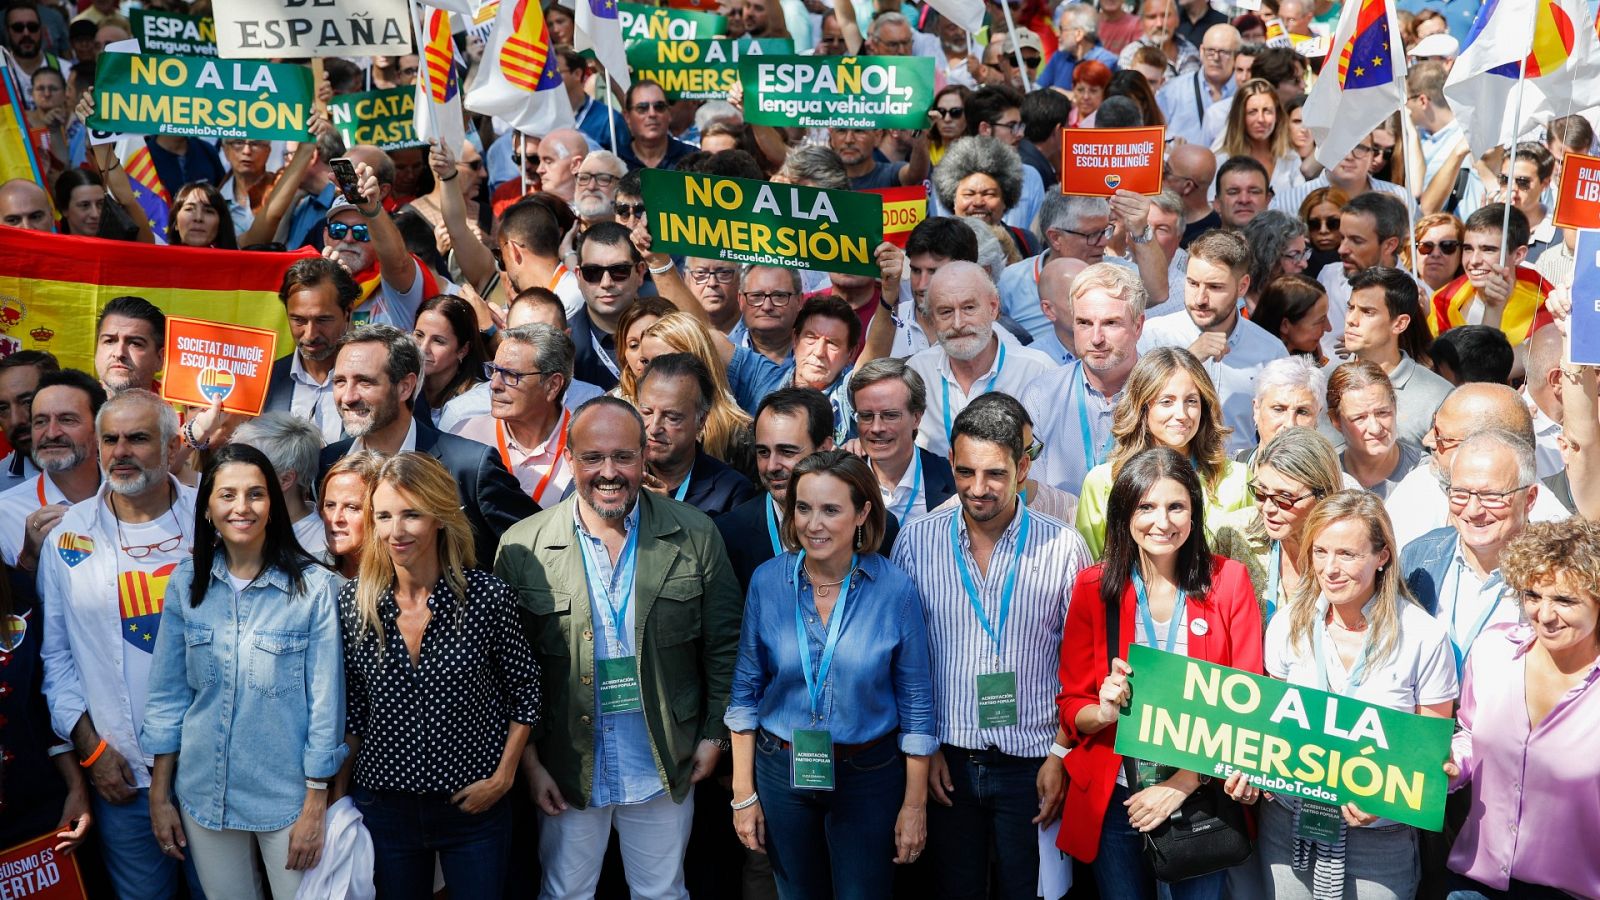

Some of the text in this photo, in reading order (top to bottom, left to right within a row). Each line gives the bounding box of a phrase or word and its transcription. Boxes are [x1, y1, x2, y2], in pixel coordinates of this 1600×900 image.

[233, 11, 408, 49] ESPAÑA
[145, 36, 191, 54] lengua
[657, 41, 700, 64] NO
[704, 40, 727, 63] A
[131, 56, 278, 93] NO A LA
[758, 57, 913, 101] ESPAÑOL,
[101, 92, 303, 131] INMERSIÓN
[759, 93, 913, 117] lengua vehicular
[159, 123, 248, 138] #EscuelaDeTodos
[798, 117, 876, 127] #EscuelaDeTodos
[1072, 141, 1154, 156] SOCIETAT BILINGÜE
[1076, 154, 1150, 168] ESCOLA BILINGÜE
[685, 175, 839, 223] NO A LA
[659, 212, 870, 264] INMERSIÓN
[719, 249, 810, 269] #EscuelaDeTodos
[177, 336, 265, 362] SOCIETAT BILINGÜE
[180, 352, 215, 369] ESCOLA
[1183, 662, 1389, 750] NO A LA
[1138, 704, 1425, 811] INMERSIÓN
[1214, 762, 1338, 802] #EuelaDeTodos
[40, 847, 54, 864] ES
